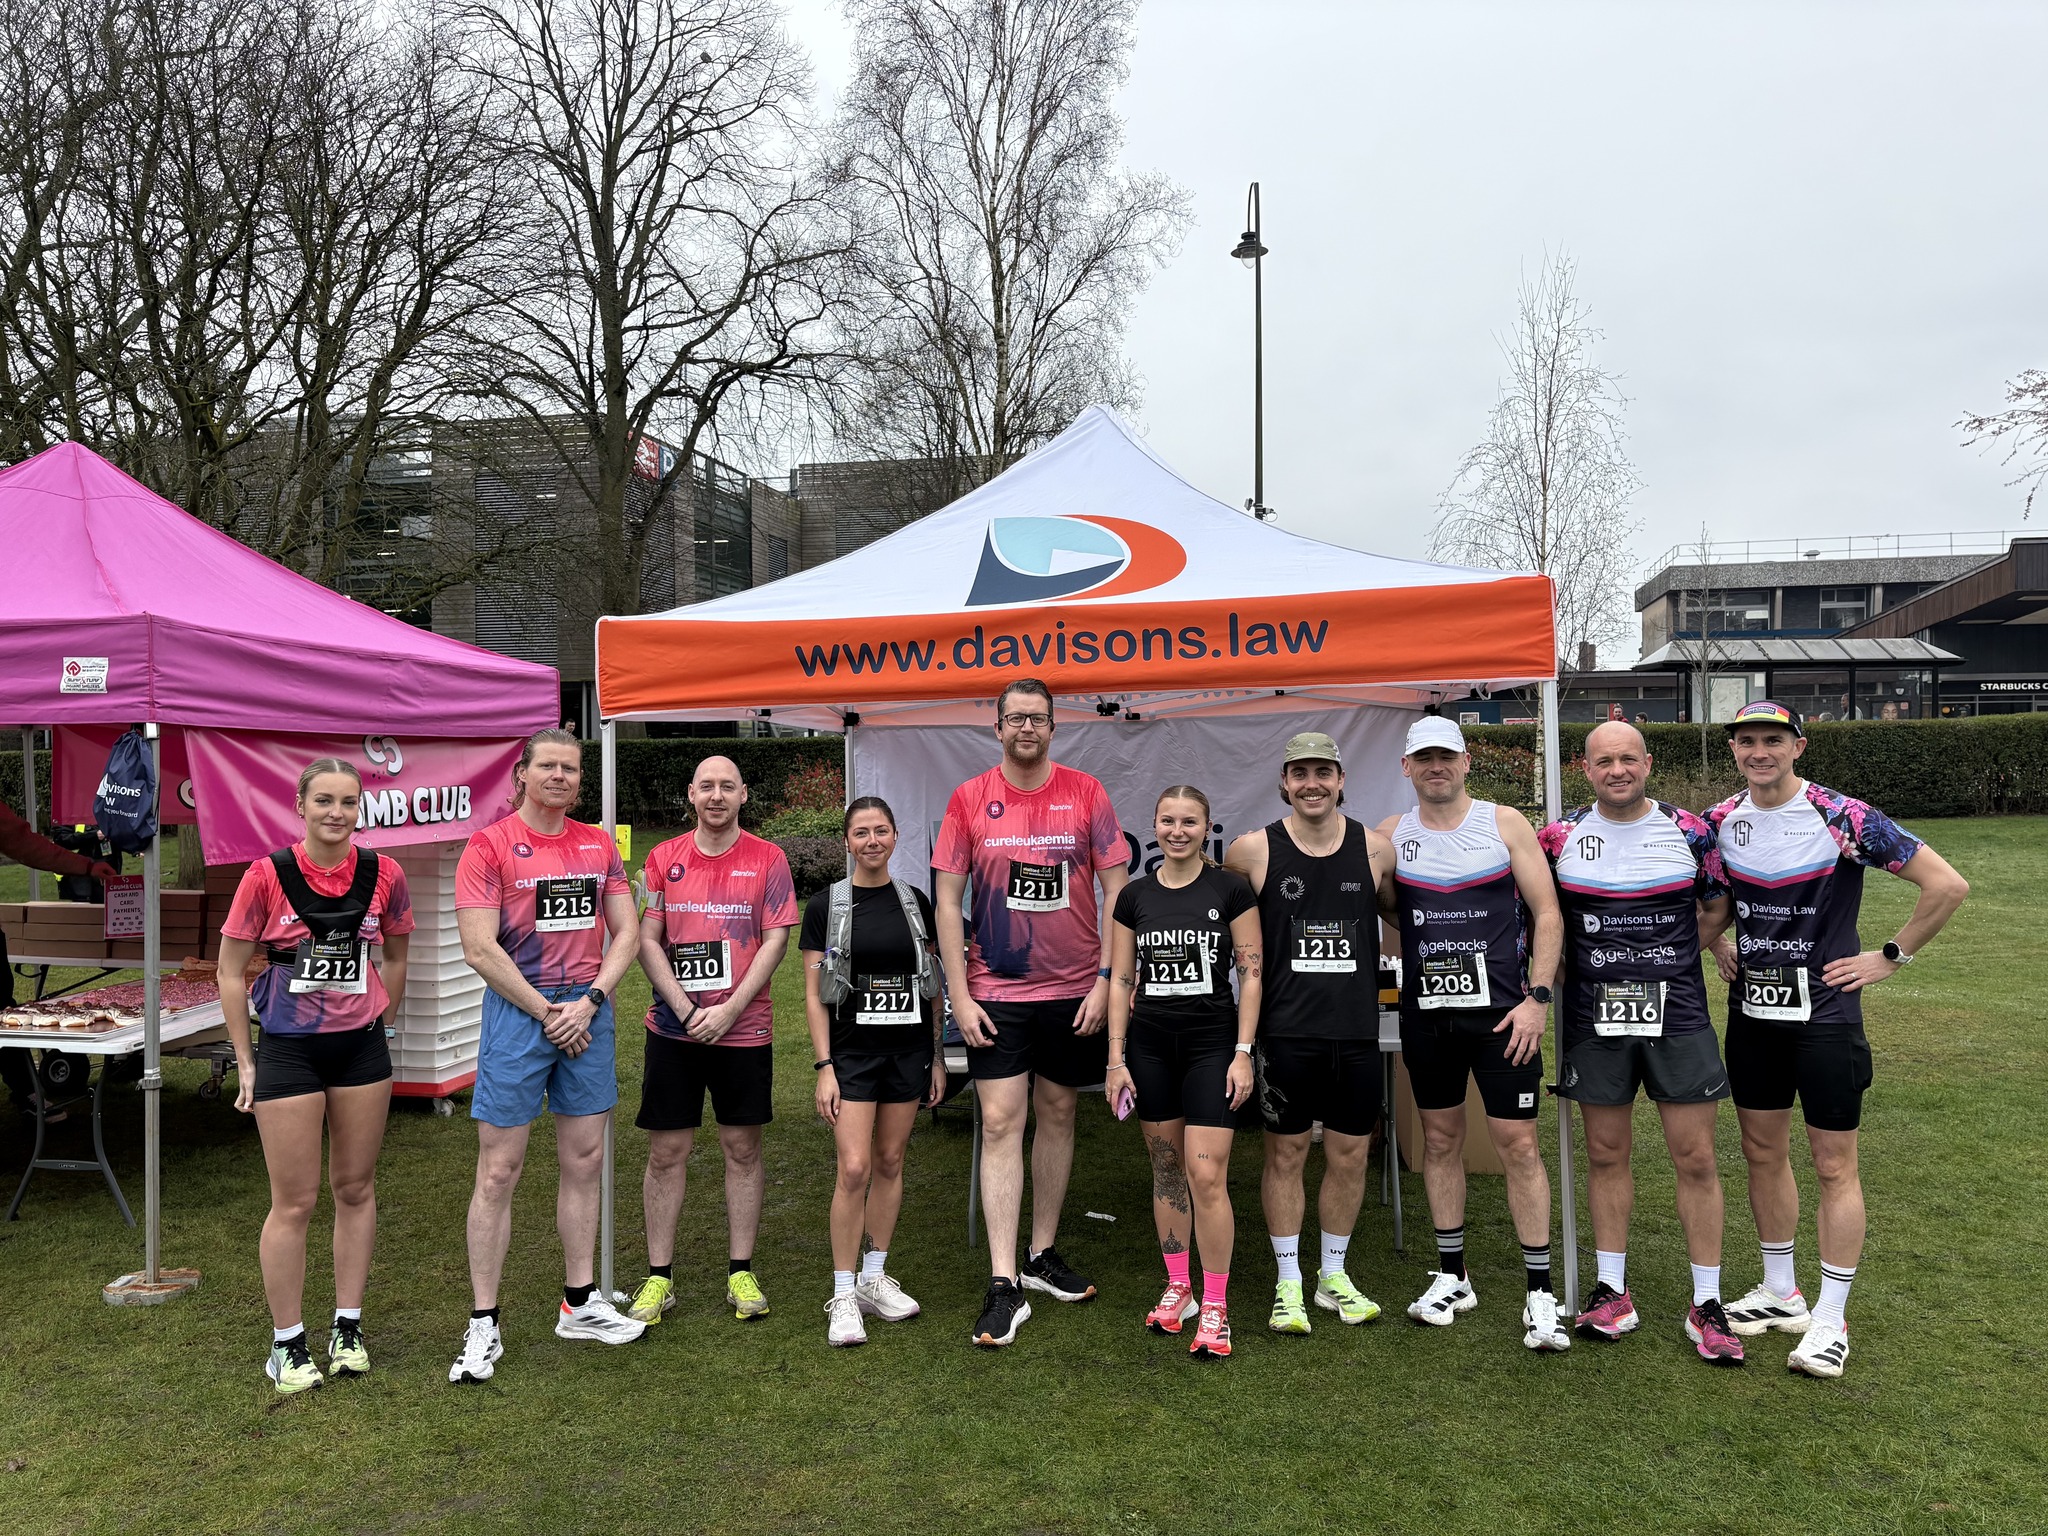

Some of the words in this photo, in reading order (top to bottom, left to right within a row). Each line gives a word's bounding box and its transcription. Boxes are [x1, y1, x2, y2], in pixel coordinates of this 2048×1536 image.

[794, 612, 1329, 678] www.davisons.law
[1980, 682, 2041, 691] STARBUCKS
[411, 785, 472, 825] CLUB
[984, 831, 1076, 848] cureleukaemia
[1732, 820, 1754, 847] TST
[1400, 840, 1421, 862] TST
[1577, 835, 1605, 861] TST
[1014, 878, 1058, 899] 1211
[543, 897, 592, 917] 1215
[1426, 910, 1467, 919] Davisons
[1468, 909, 1488, 918] Law
[1752, 902, 1791, 915] Davisons
[1793, 906, 1816, 915] Law
[1603, 914, 1653, 925] Davisons
[1655, 913, 1676, 924] Law
[1136, 929, 1222, 948] MIDNIGHT
[1298, 939, 1351, 958] 1213
[1428, 938, 1488, 954] gelpacks
[1751, 936, 1815, 953] gelpacks
[1606, 945, 1676, 963] gelpacks
[300, 958, 357, 980] 1212
[673, 958, 719, 979] 1210
[1149, 962, 1198, 982] 1214
[1420, 973, 1474, 995] 1208
[1745, 982, 1793, 1005] 1207
[864, 993, 910, 1011] 1217
[1599, 1001, 1658, 1022] 1216
